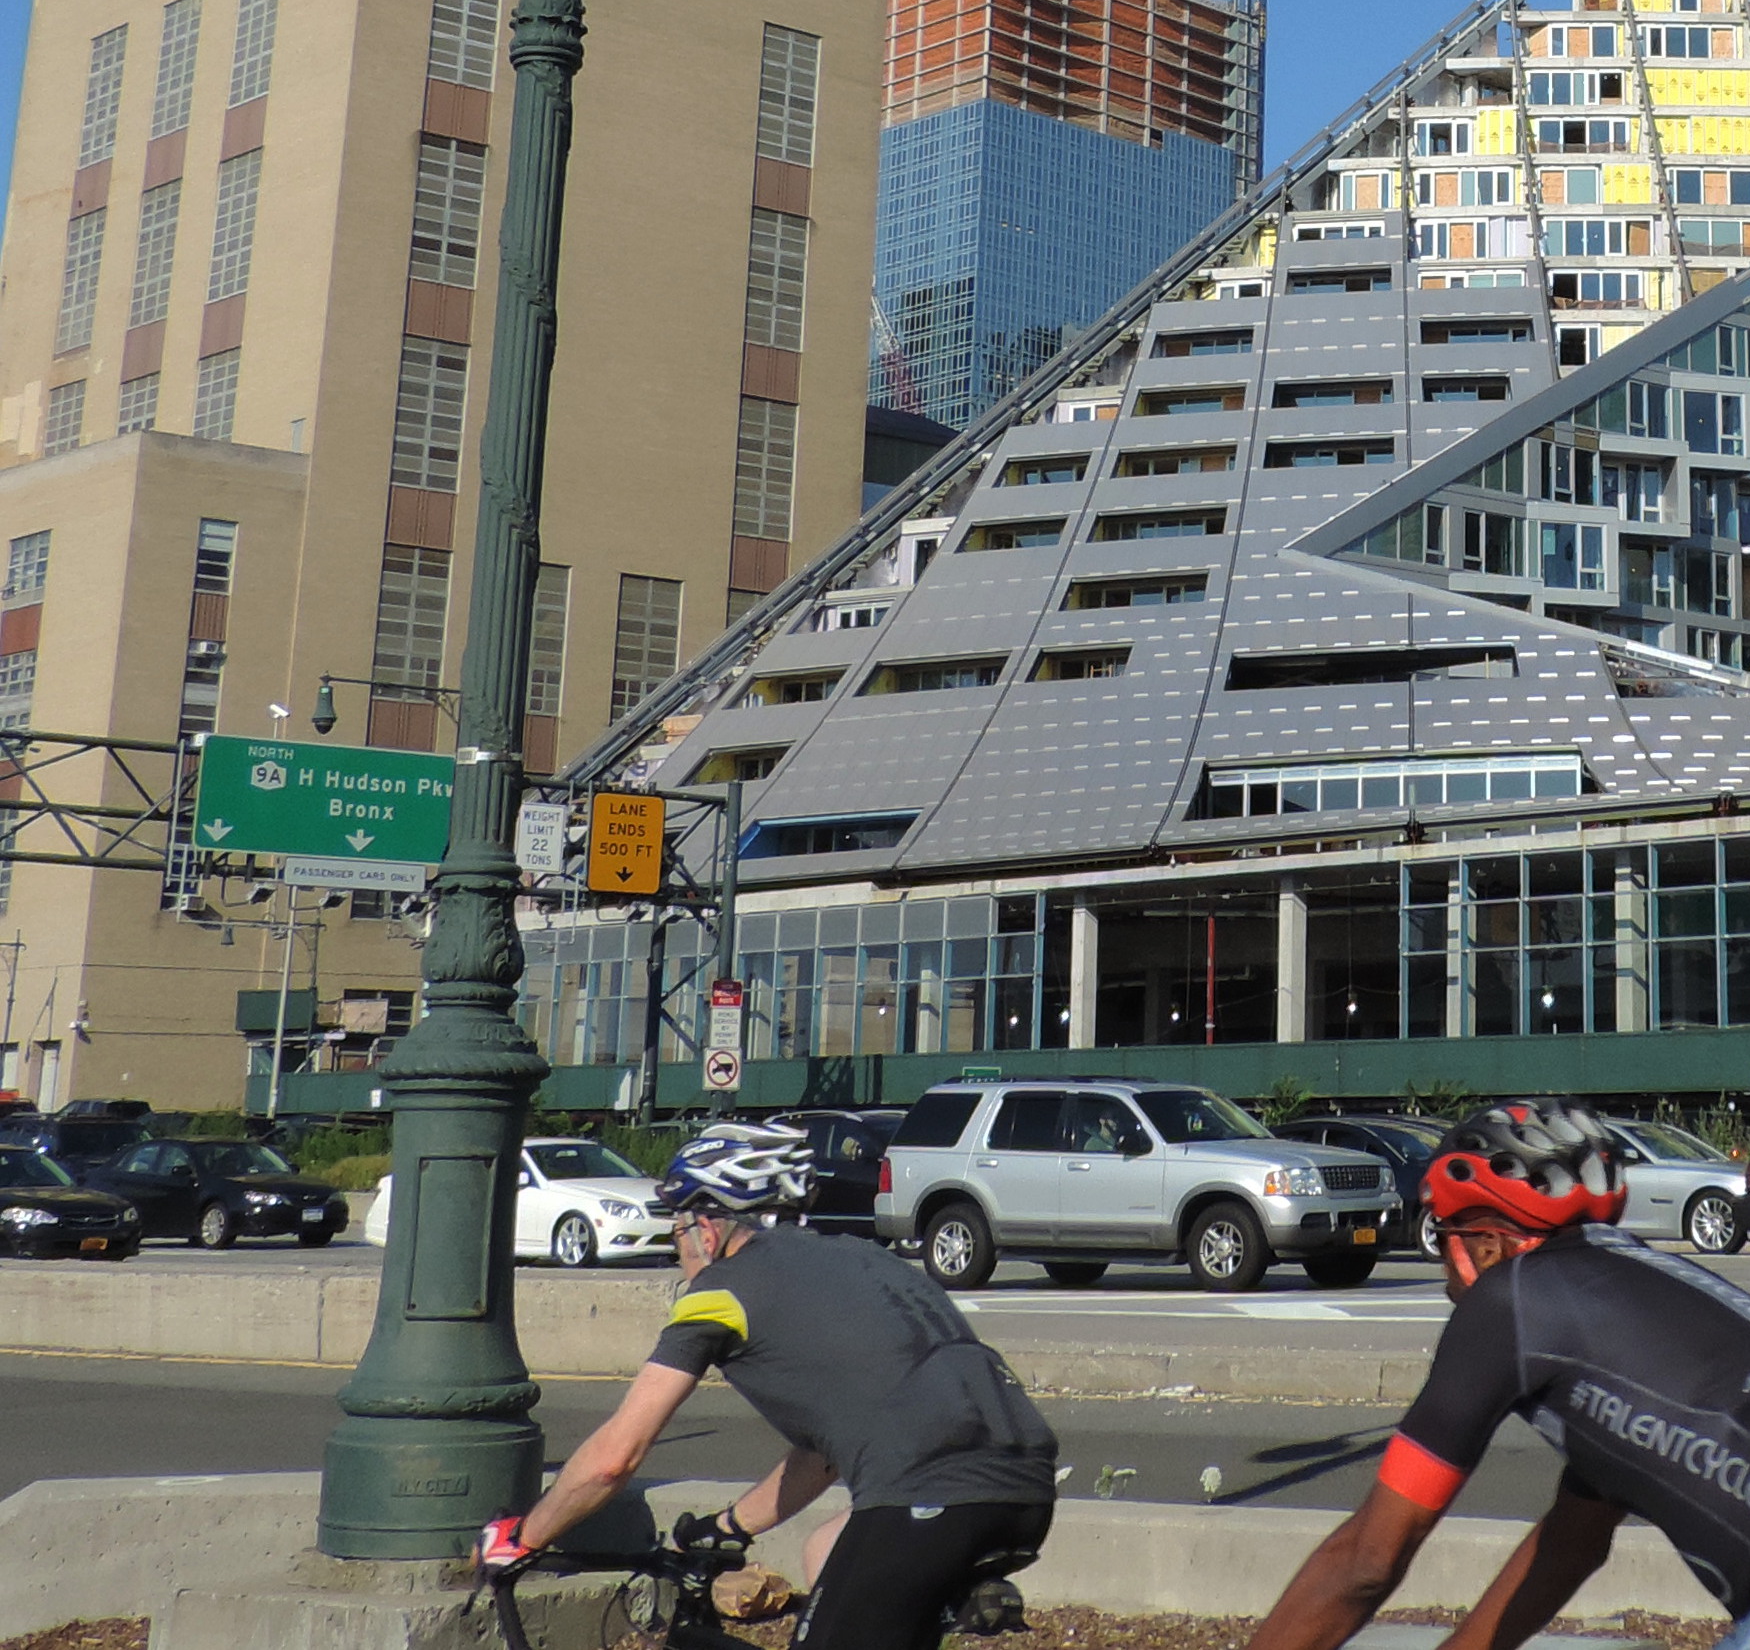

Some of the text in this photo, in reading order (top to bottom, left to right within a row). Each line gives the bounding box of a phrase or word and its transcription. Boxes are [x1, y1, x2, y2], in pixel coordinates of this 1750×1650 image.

[247, 746, 295, 761] NORTH
[255, 767, 282, 785] 9A
[299, 768, 314, 786] H
[325, 770, 406, 794] Hudson
[328, 798, 395, 821] Bronx
[523, 810, 561, 823] WEIGHT
[609, 802, 648, 817] LANE
[527, 825, 555, 836] LIMIT
[608, 822, 646, 837] ENDS
[531, 838, 549, 852] 22
[599, 842, 653, 858] 500 FT
[526, 854, 552, 866] TONS
[293, 866, 417, 883] PASSENGER CARS ONLY
